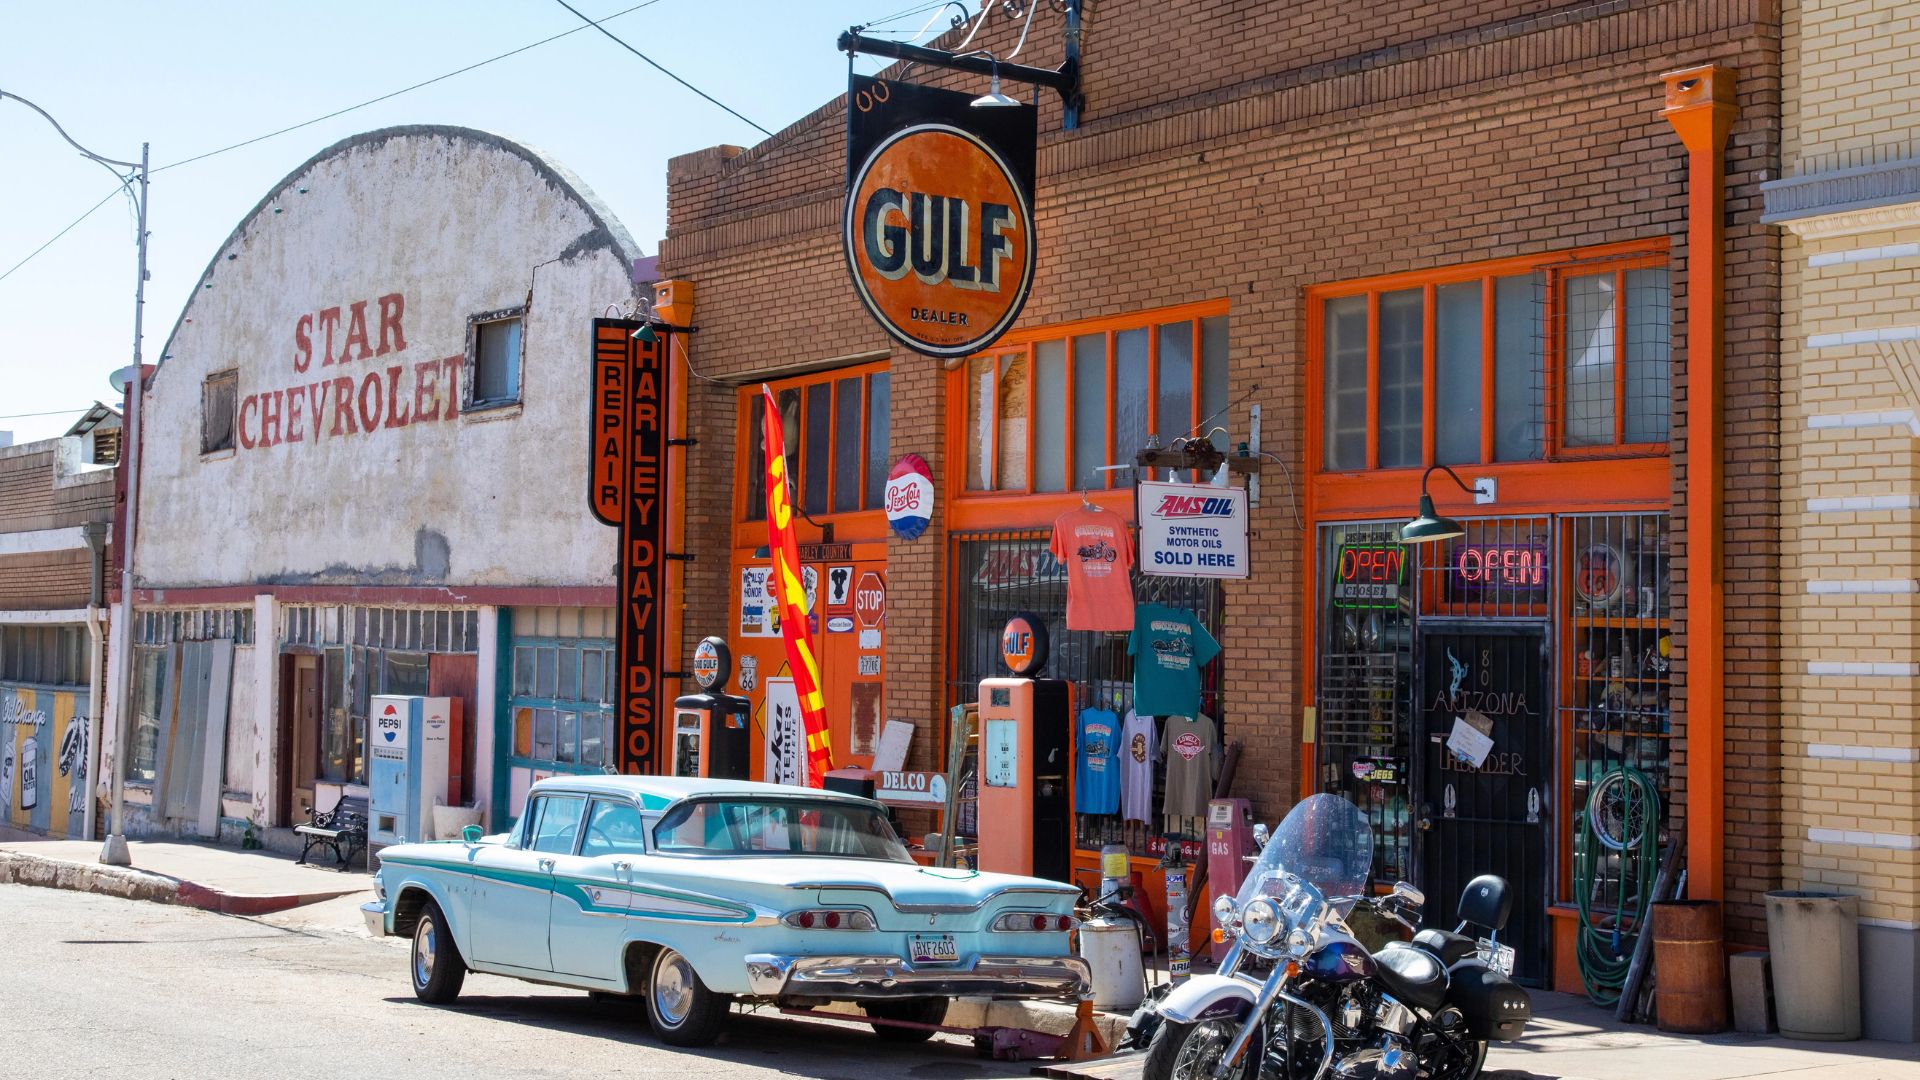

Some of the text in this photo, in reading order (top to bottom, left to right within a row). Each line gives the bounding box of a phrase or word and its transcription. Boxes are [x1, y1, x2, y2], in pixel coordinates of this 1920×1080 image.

[863, 187, 1017, 293] GULF
[910, 307, 970, 327] DEALER
[293, 293, 407, 374] STAR
[238, 353, 465, 450] CHEVROLET
[601, 365, 621, 506] REPAIR
[633, 338, 658, 525] HARLEY
[1156, 495, 1233, 518] AMSOIL
[1169, 526, 1219, 538] SYNTHETIC
[800, 545, 848, 559] ARLEY COUNTRY
[1166, 537, 1222, 549] MOTOR OILS
[1154, 551, 1235, 567] SOLD HERE
[1341, 550, 1404, 580] OPEN
[1459, 549, 1541, 584] OPEN
[752, 572, 765, 584] ALSO
[857, 589, 883, 610] STOP
[1345, 586, 1388, 596] CLOSED
[1003, 632, 1031, 656] GULF
[703, 659, 718, 669] GULF
[742, 676, 754, 689] 66
[1432, 689, 1530, 714] ARIZONA
[15, 698, 46, 735] Change
[378, 718, 402, 729] PEPSI
[23, 768, 35, 782] OIL
[882, 771, 926, 790] DELCO
[23, 781, 36, 791] FILTER
[1211, 841, 1229, 856] GAS
[916, 941, 956, 956] BXF2603
